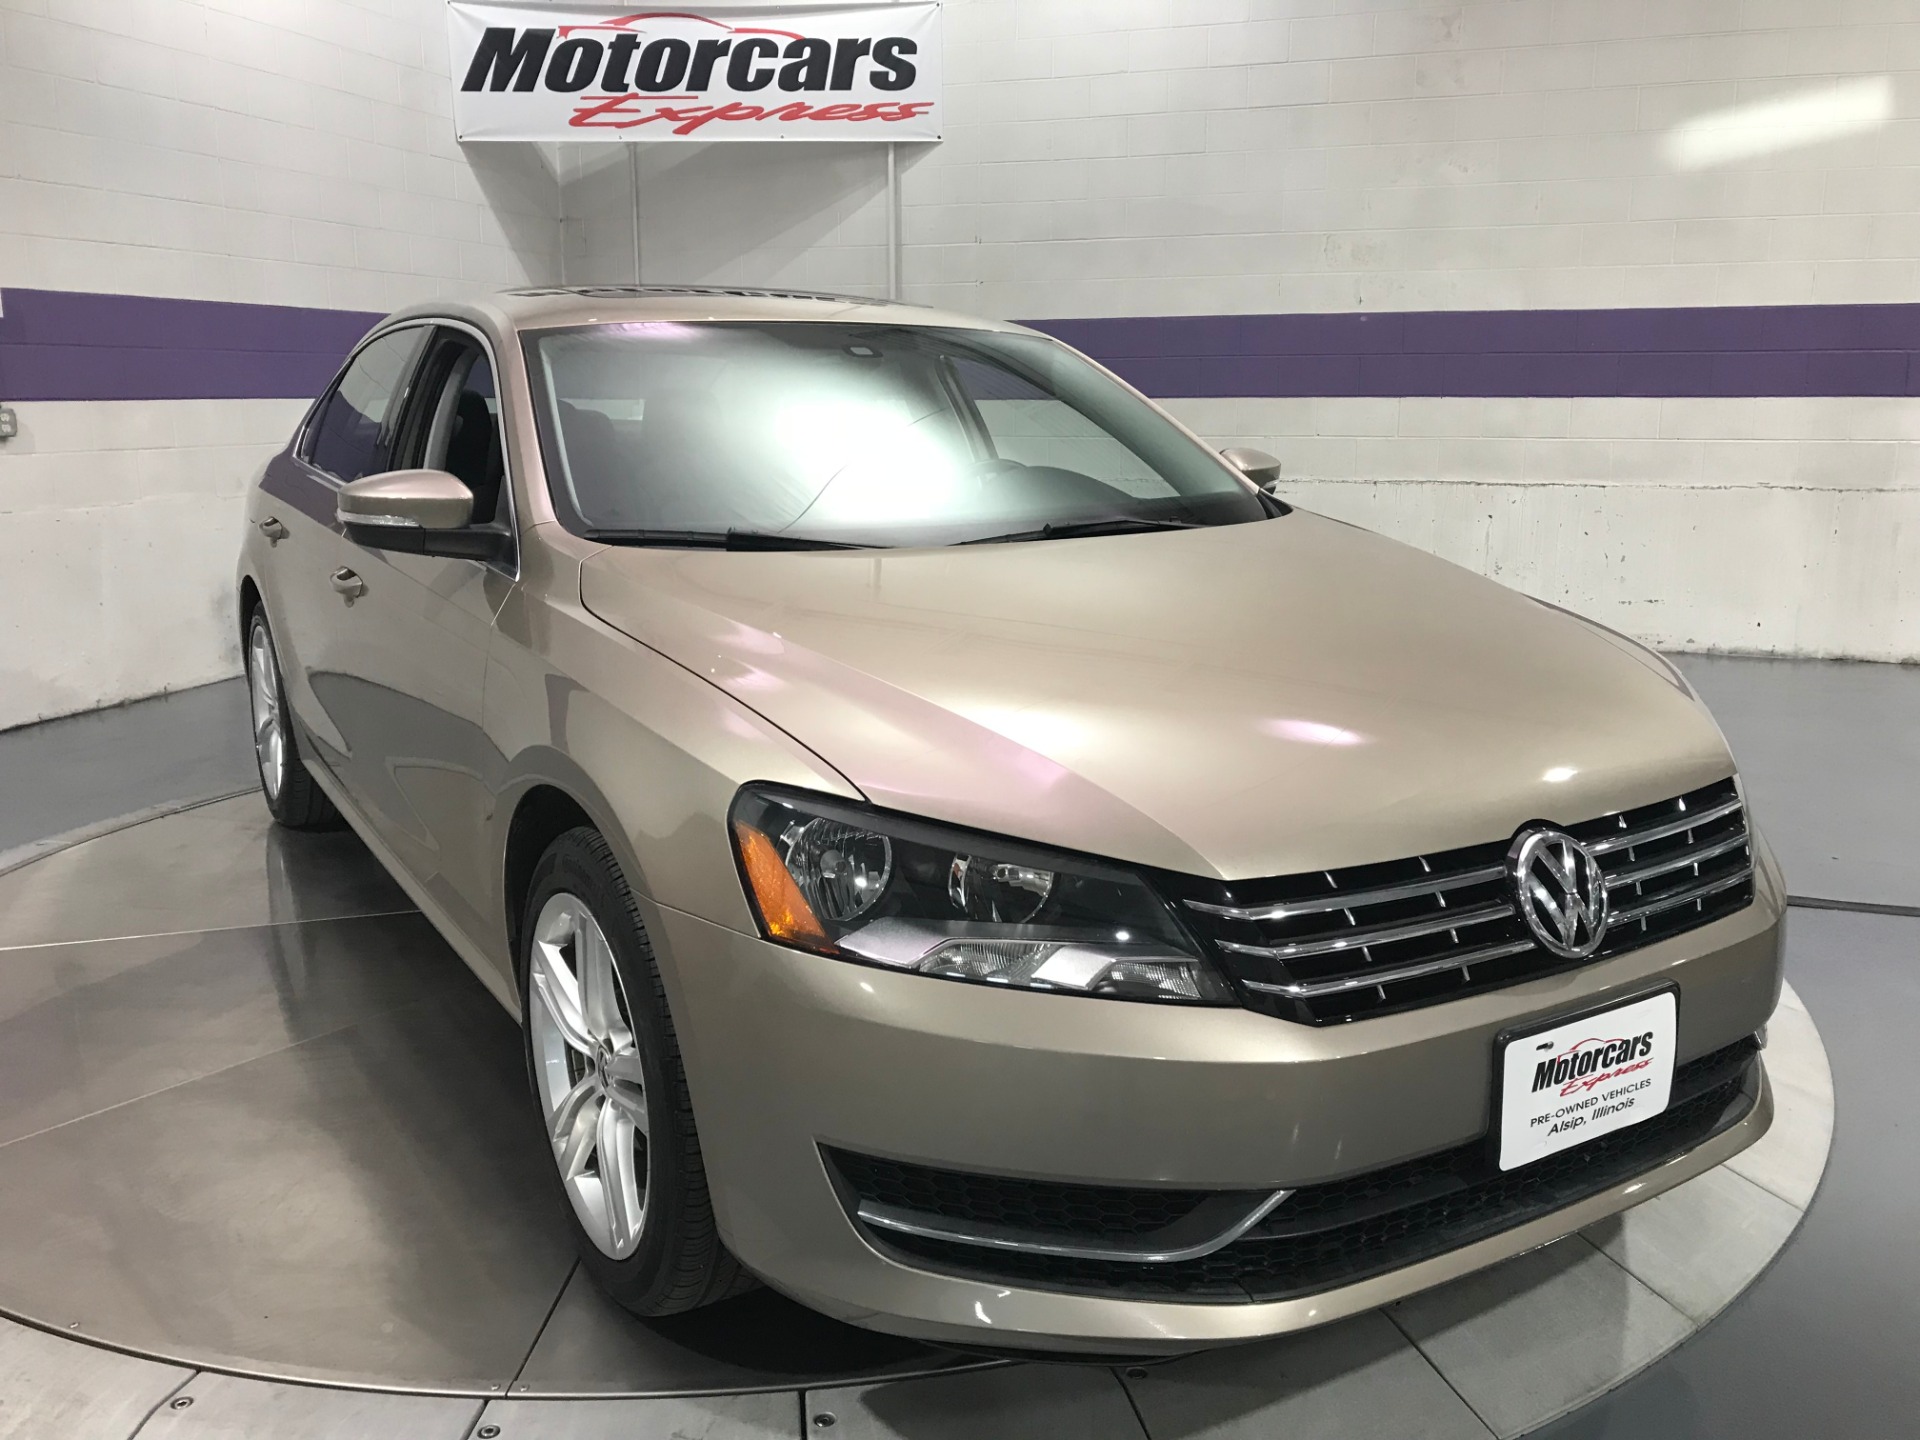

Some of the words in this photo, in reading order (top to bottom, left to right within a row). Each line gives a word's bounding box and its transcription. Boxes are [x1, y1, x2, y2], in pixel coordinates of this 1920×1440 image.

[460, 27, 917, 93] Motorcars
[568, 92, 935, 135] Express
[1531, 1031, 1653, 1093] Motorcars
[1559, 1057, 1654, 1098] Express
[1530, 1096, 1599, 1128] PRE-OWNED
[1601, 1078, 1652, 1102] VEHICLES
[1546, 1115, 1587, 1137] Alsip,
[1591, 1096, 1636, 1121] Illinois
